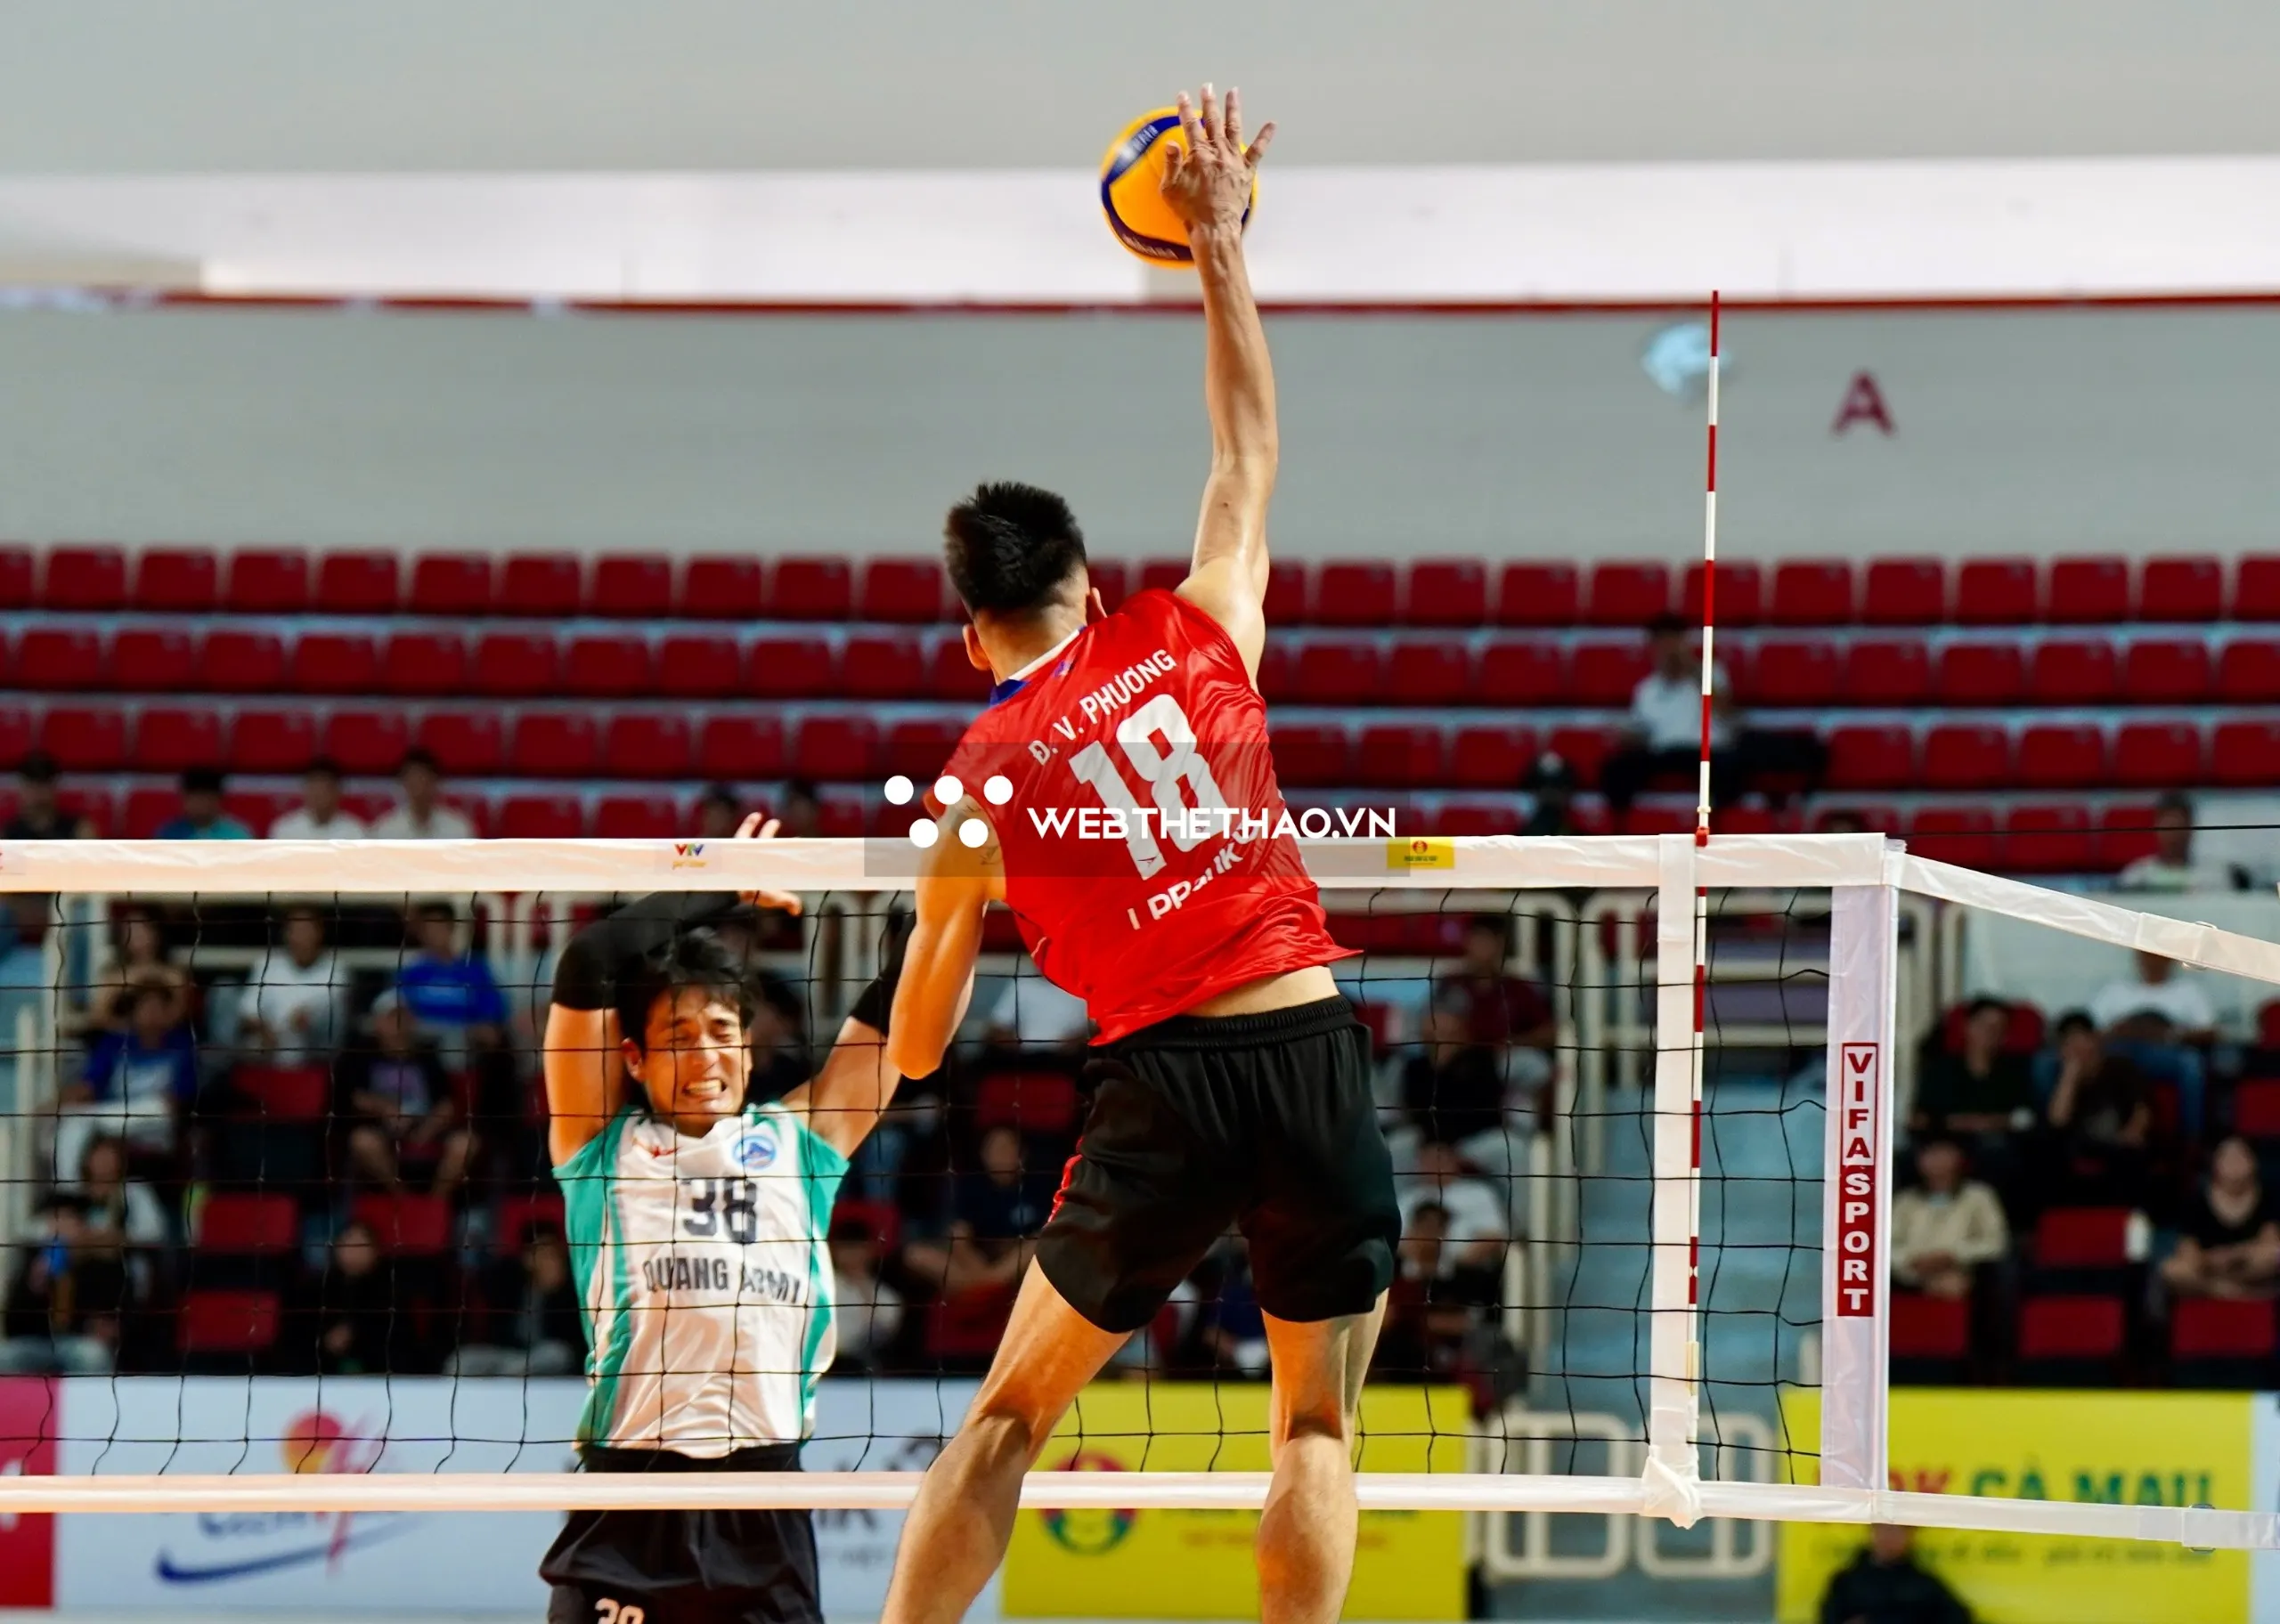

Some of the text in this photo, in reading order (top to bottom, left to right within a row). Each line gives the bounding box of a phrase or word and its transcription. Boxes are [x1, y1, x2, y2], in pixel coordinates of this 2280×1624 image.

[1830, 370, 1897, 437] A
[1052, 715, 1085, 741] V.
[1068, 694, 1233, 881] 18
